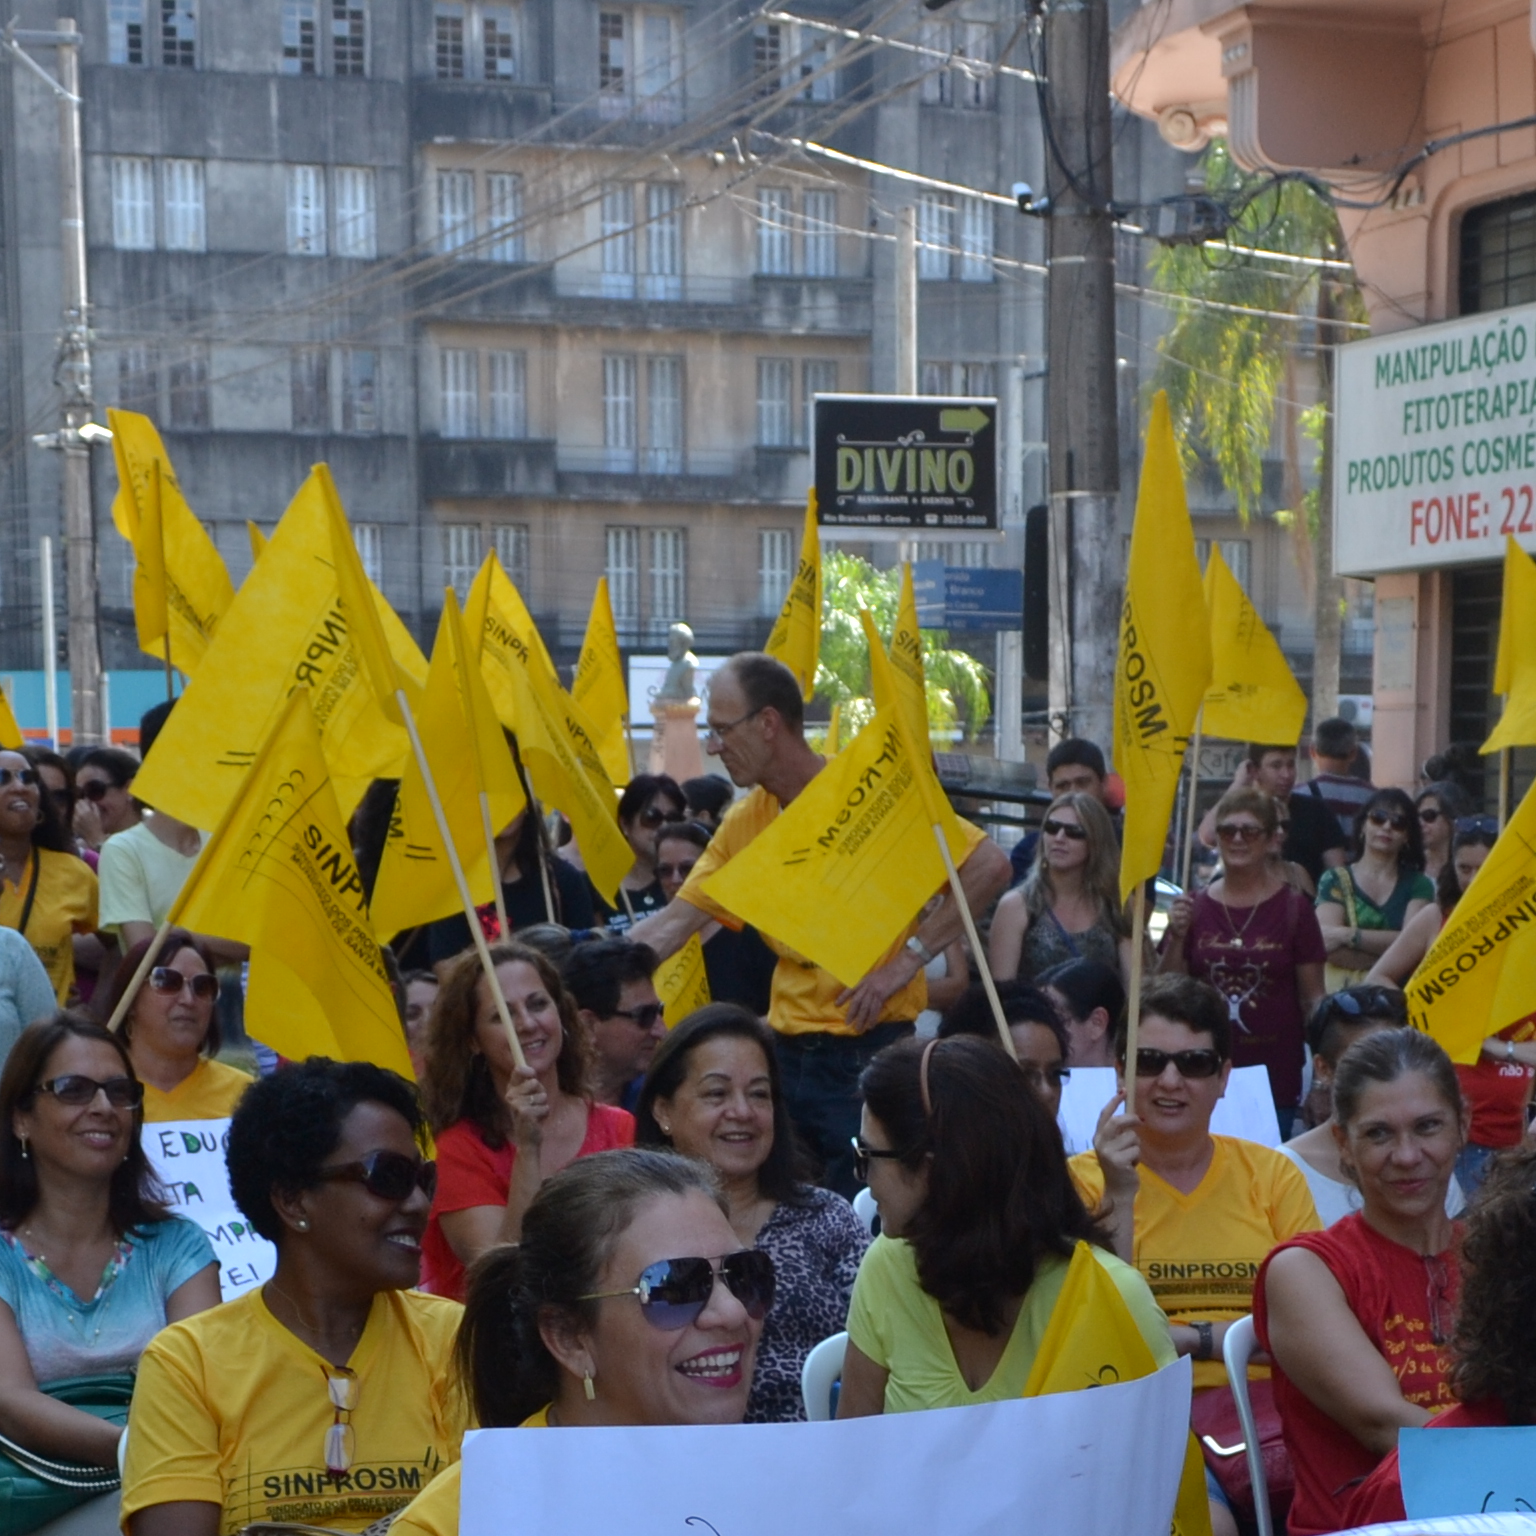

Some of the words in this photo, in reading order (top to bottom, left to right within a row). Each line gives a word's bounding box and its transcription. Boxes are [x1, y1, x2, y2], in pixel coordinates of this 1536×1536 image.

[1375, 317, 1527, 389] MANIPULAÇÃO
[836, 447, 975, 494] DIVINO
[1348, 445, 1454, 494] PRODUTOS
[857, 495, 909, 505] RESTAURANTE
[921, 496, 956, 506] EVENTOS
[1410, 492, 1489, 546] FONE:
[263, 1466, 421, 1499] SINPROSM
